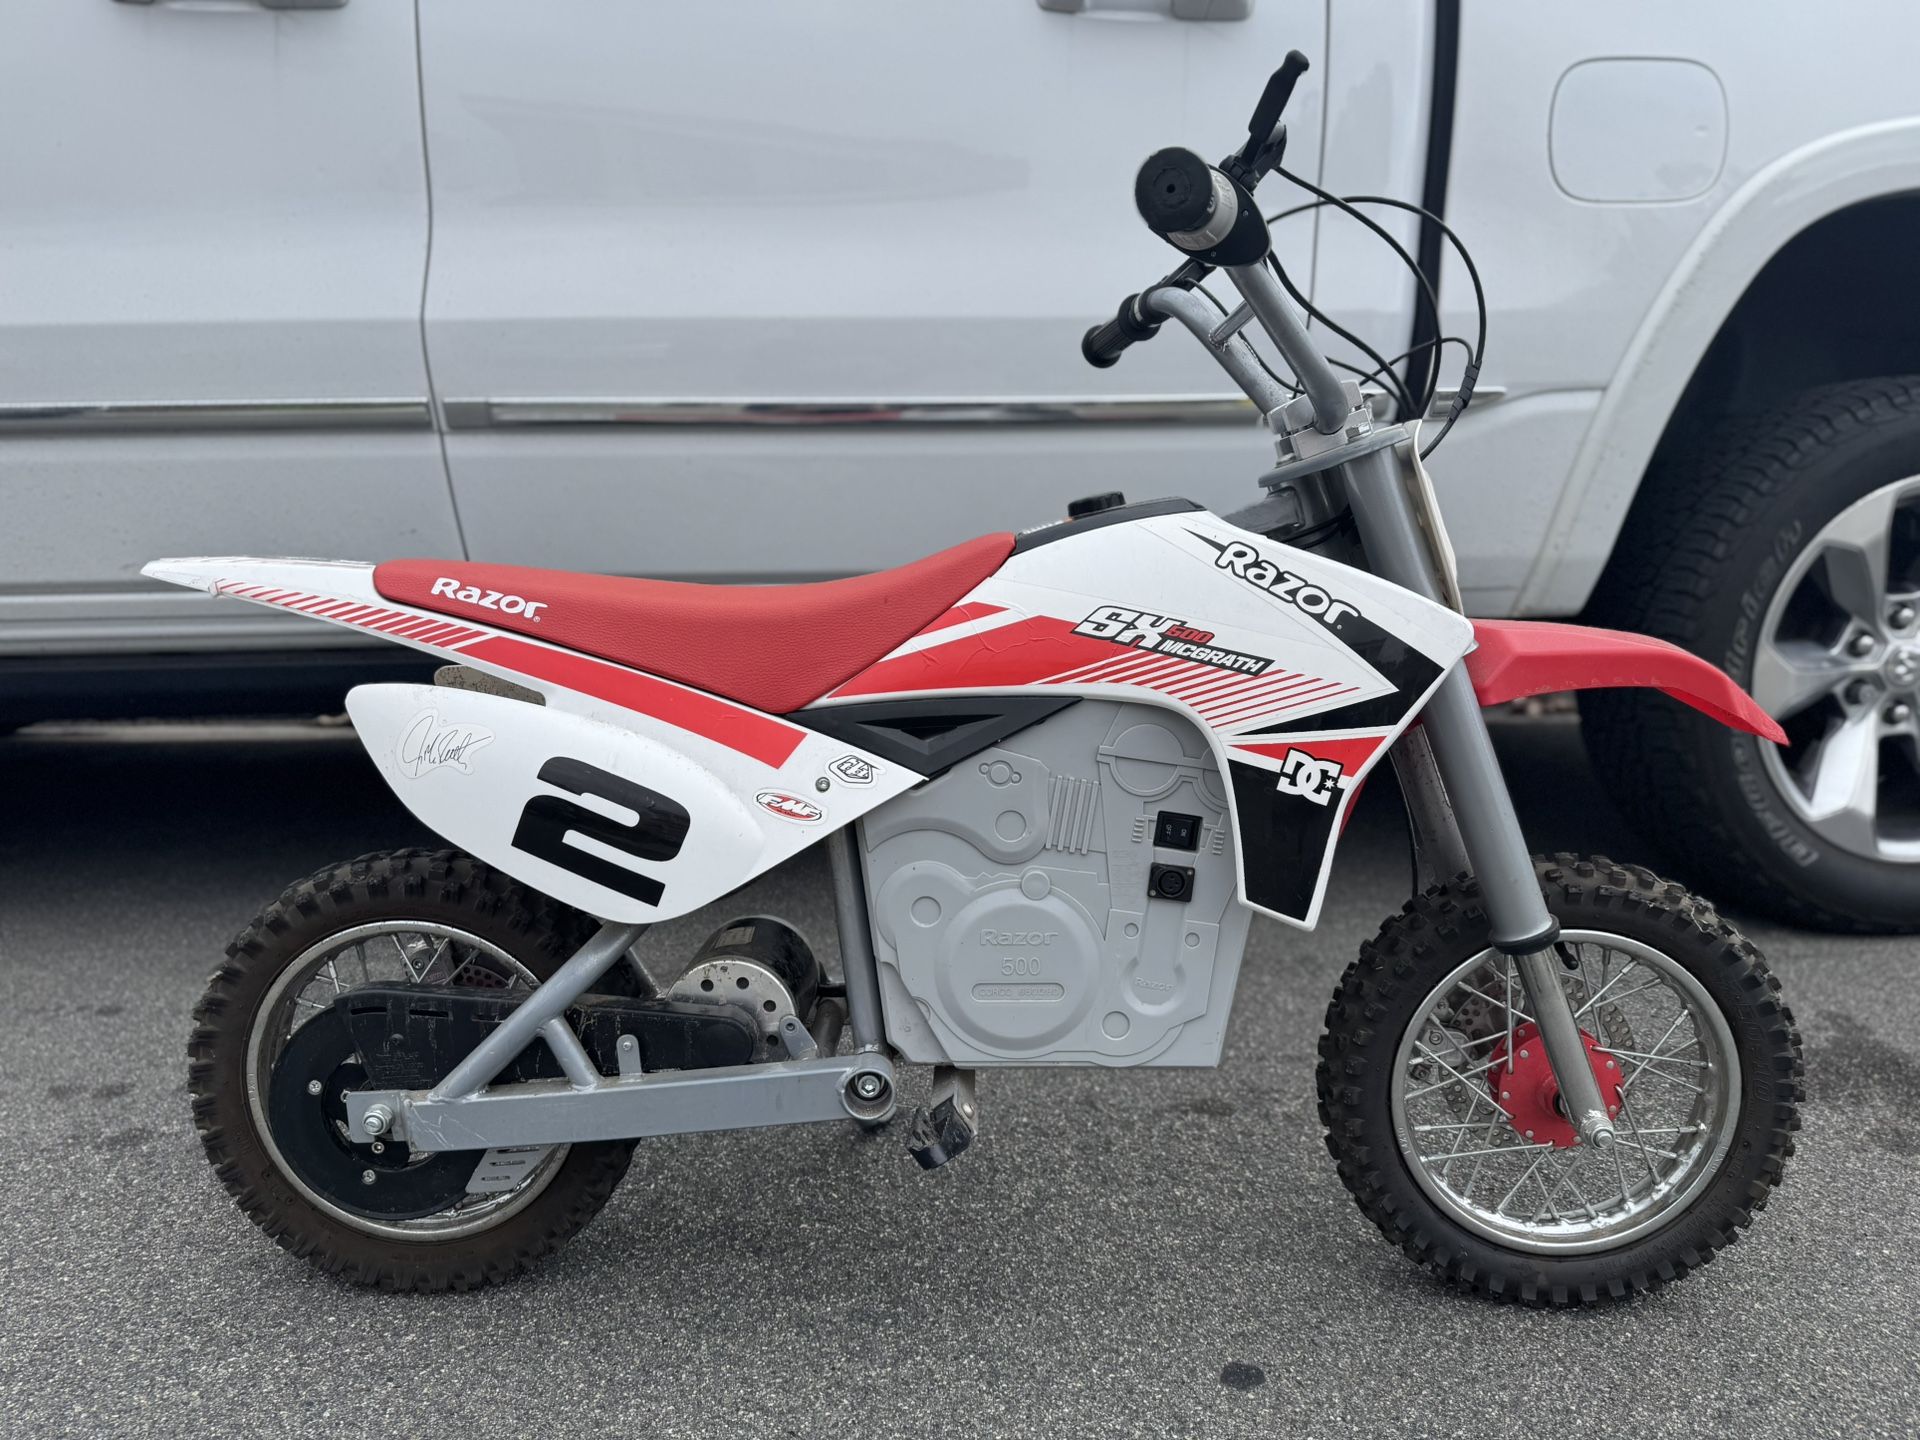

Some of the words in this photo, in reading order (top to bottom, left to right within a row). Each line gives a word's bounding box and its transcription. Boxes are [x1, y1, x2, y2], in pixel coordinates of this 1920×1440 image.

[431, 577, 547, 620] Razor
[1214, 540, 1361, 626] Razor
[1073, 605, 1186, 650] SX
[1164, 625, 1215, 644] 500
[1159, 640, 1265, 673] MCGRATH
[1276, 748, 1344, 806] DC
[757, 792, 822, 818] FMF
[511, 756, 690, 907] 2
[980, 929, 1058, 945] Razor
[1001, 957, 1041, 975] 500
[1136, 977, 1176, 992] Razor
